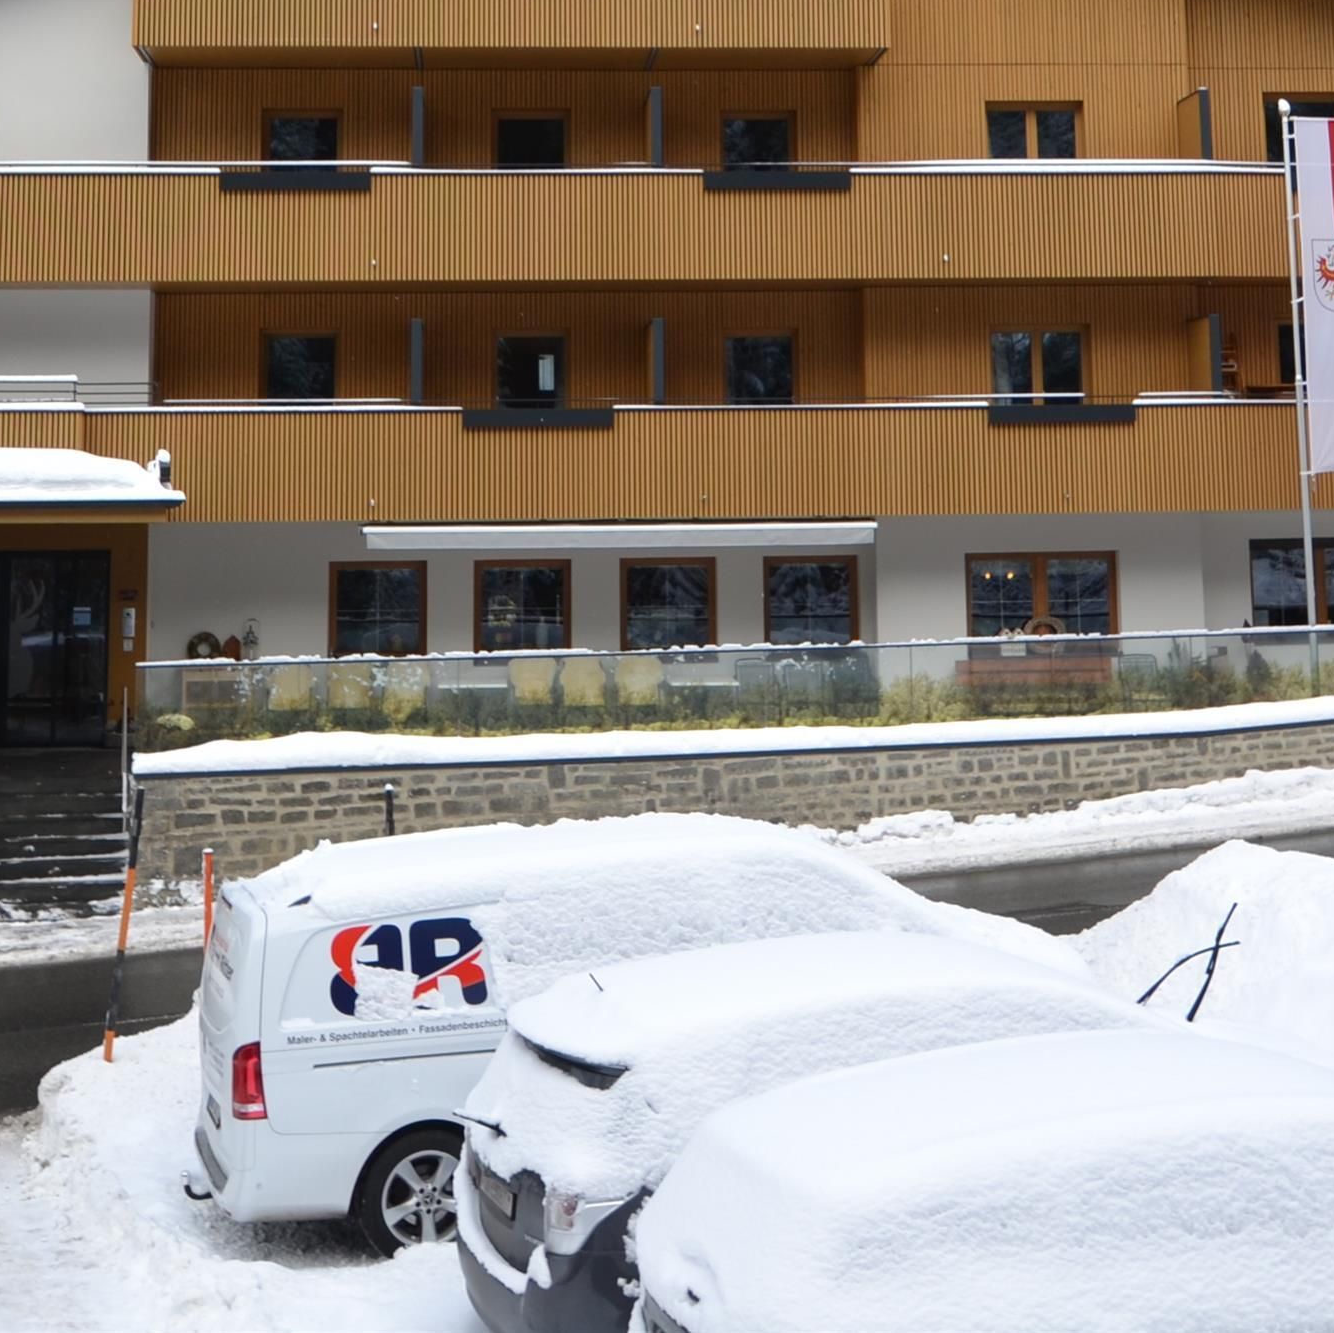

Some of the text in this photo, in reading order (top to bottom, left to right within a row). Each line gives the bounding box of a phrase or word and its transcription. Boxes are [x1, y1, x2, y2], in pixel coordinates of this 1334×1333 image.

[286, 1035, 317, 1045] Maler-
[319, 1033, 327, 1043] &
[329, 1027, 408, 1043] Spachtelarbeiten
